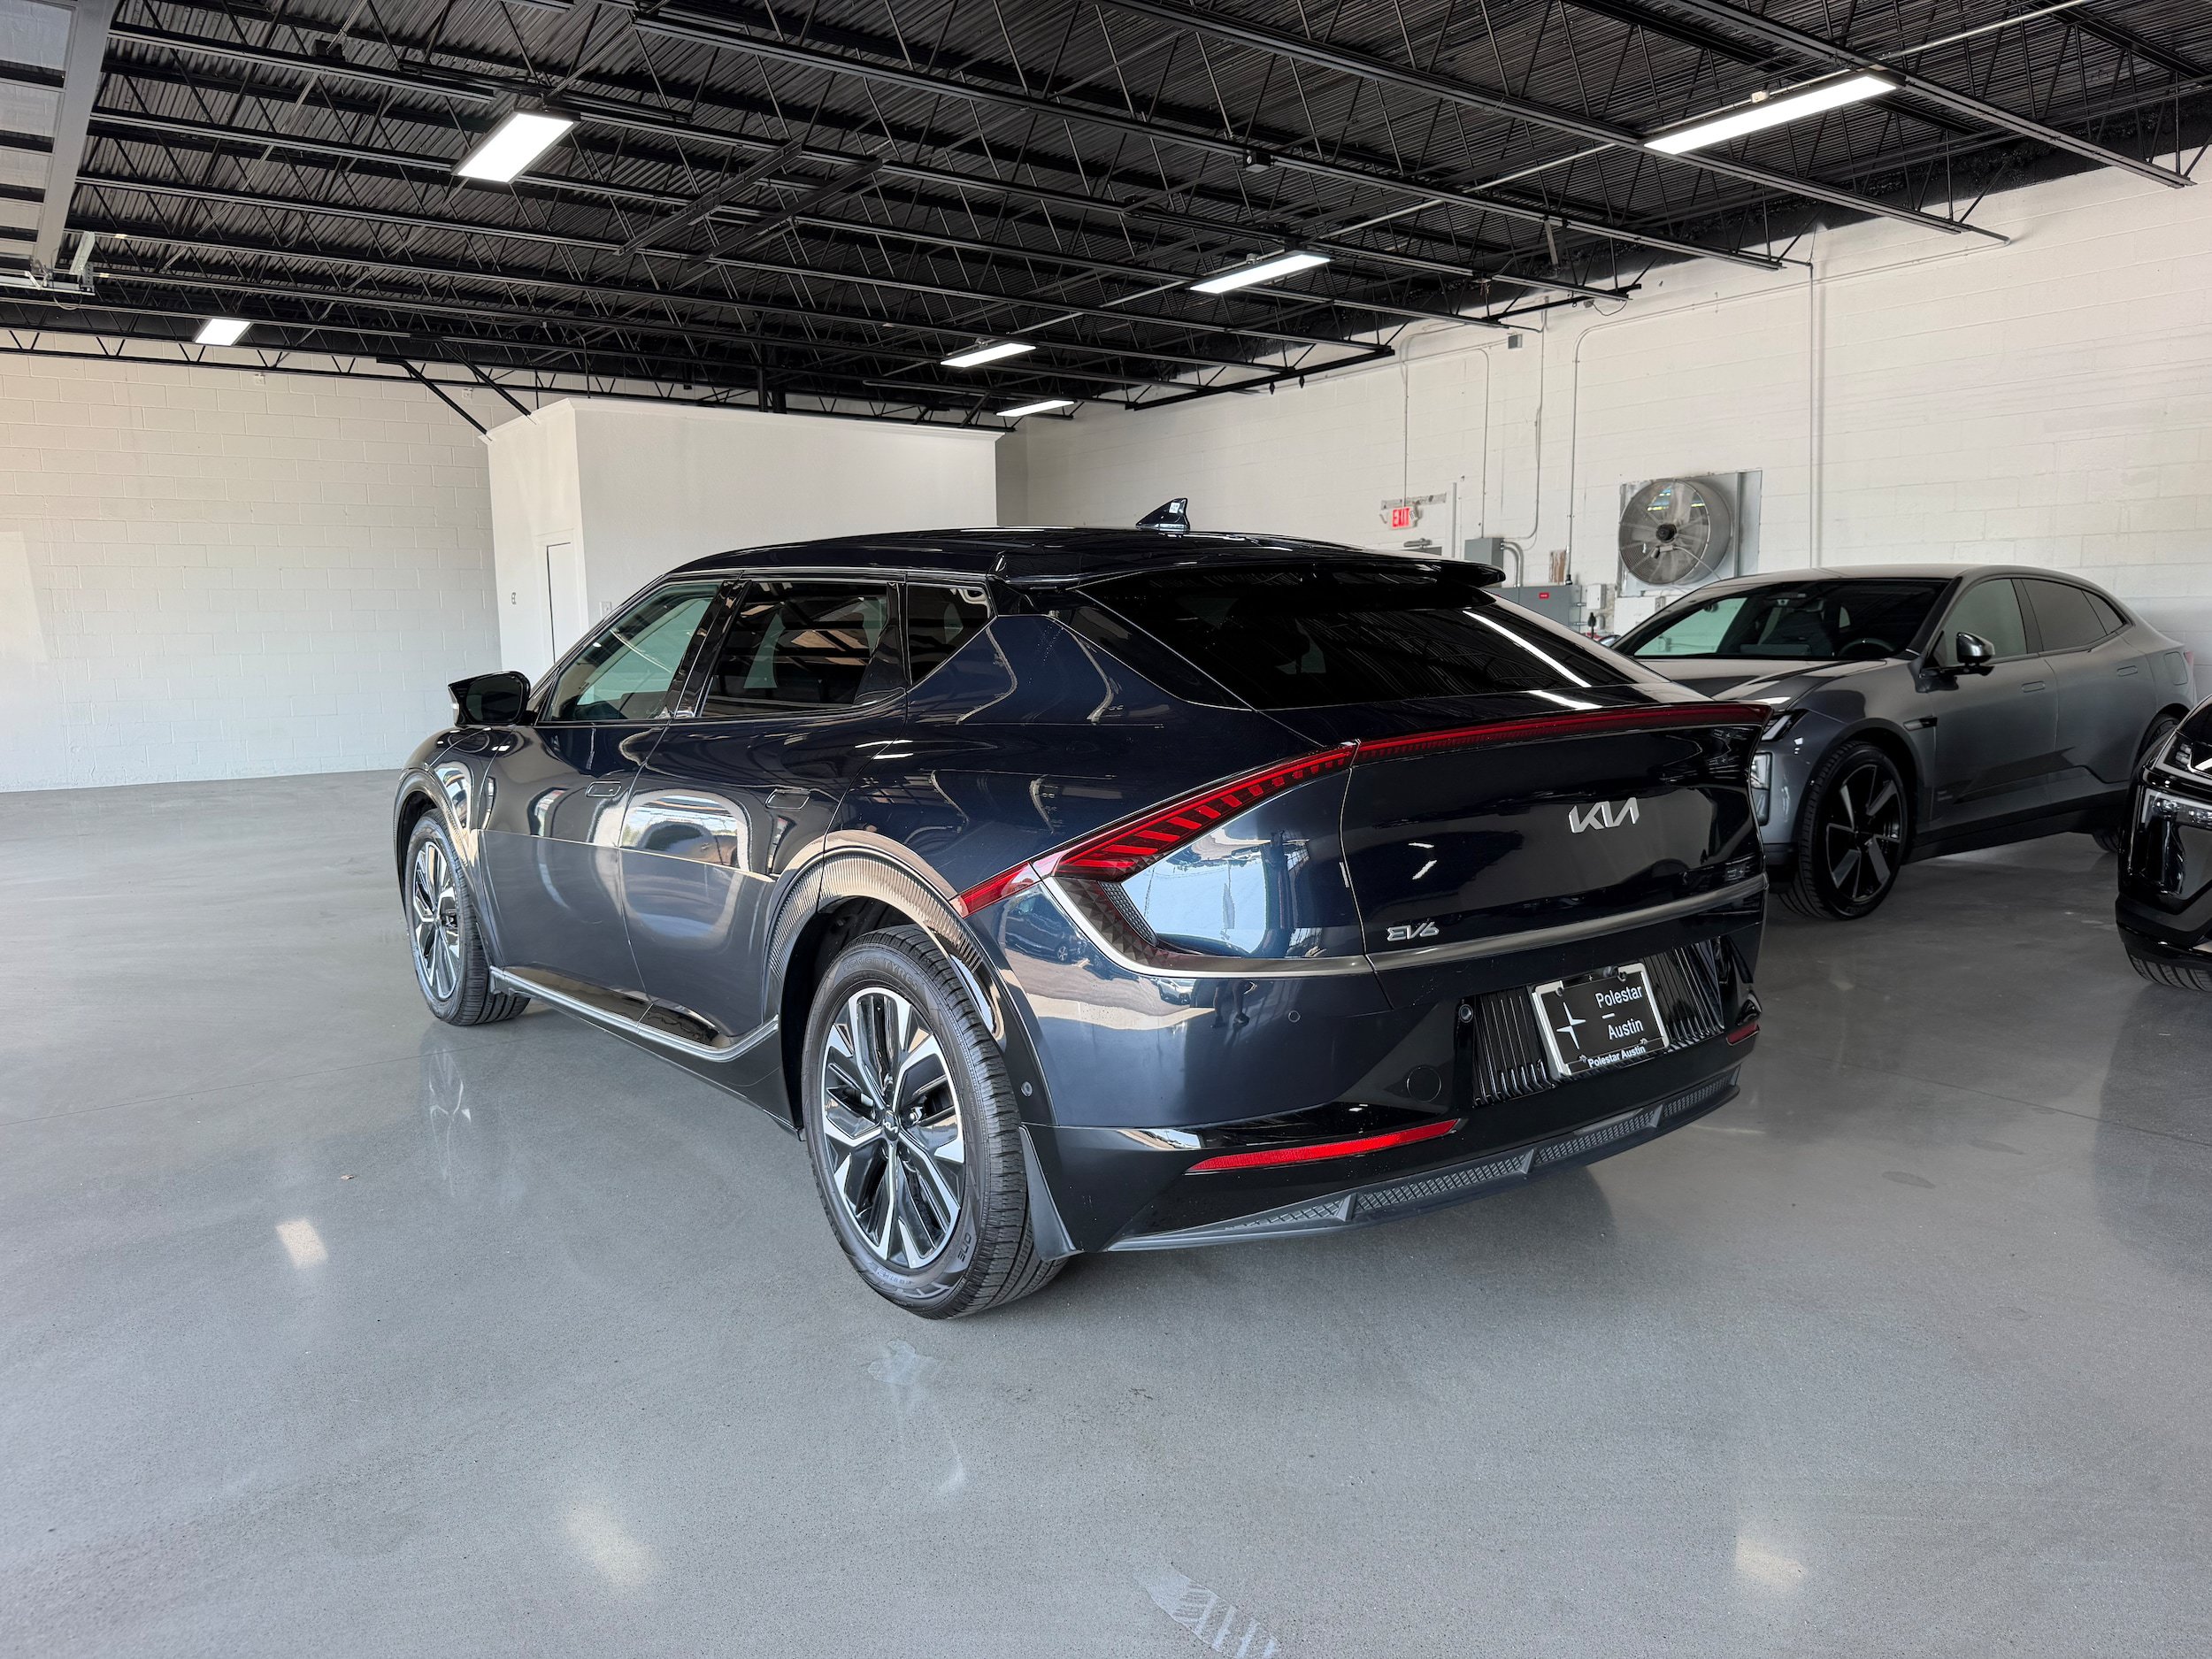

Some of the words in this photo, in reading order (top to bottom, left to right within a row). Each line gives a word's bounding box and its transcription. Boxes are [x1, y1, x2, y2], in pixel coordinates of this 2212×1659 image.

[1393, 507, 1409, 527] EXIT
[1568, 797, 1640, 833] KIA
[1386, 921, 1440, 942] EV6
[1594, 985, 1643, 1009] Polestar
[1608, 1018, 1644, 1041] Austin
[1587, 1052, 1620, 1068] Polestar
[1621, 1045, 1647, 1060] Austin
